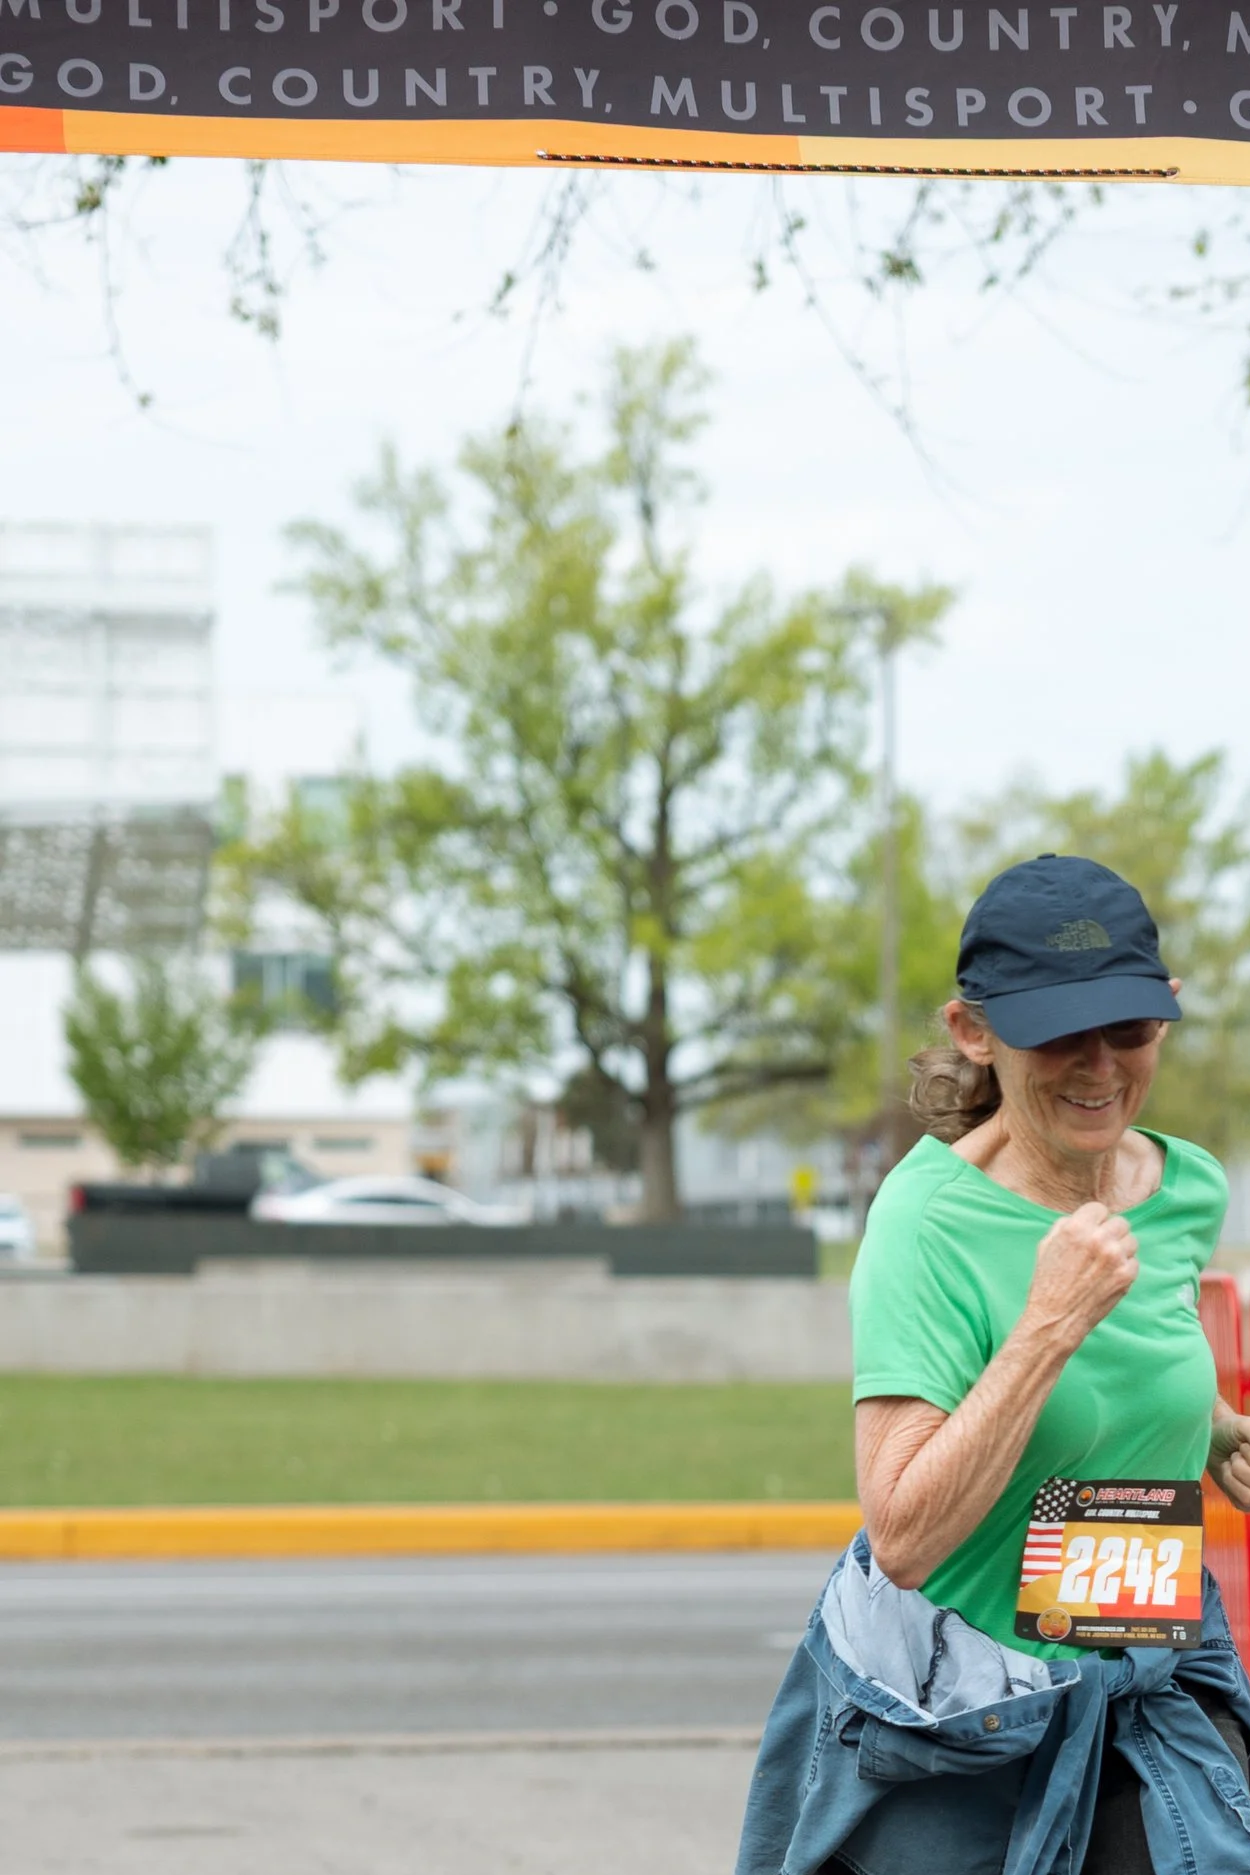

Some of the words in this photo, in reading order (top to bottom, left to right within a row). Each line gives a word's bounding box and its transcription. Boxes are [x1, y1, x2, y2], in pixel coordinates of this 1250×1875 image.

[591, 0, 770, 50] GOD,
[808, 4, 1190, 52] COUNTRY,
[0, 53, 178, 106] GOD,
[218, 65, 613, 114] COUNTRY,
[650, 75, 1153, 128] MULTISPORT
[1095, 1487, 1176, 1503] HEARTLAND
[1056, 1535, 1184, 1606] 2242
